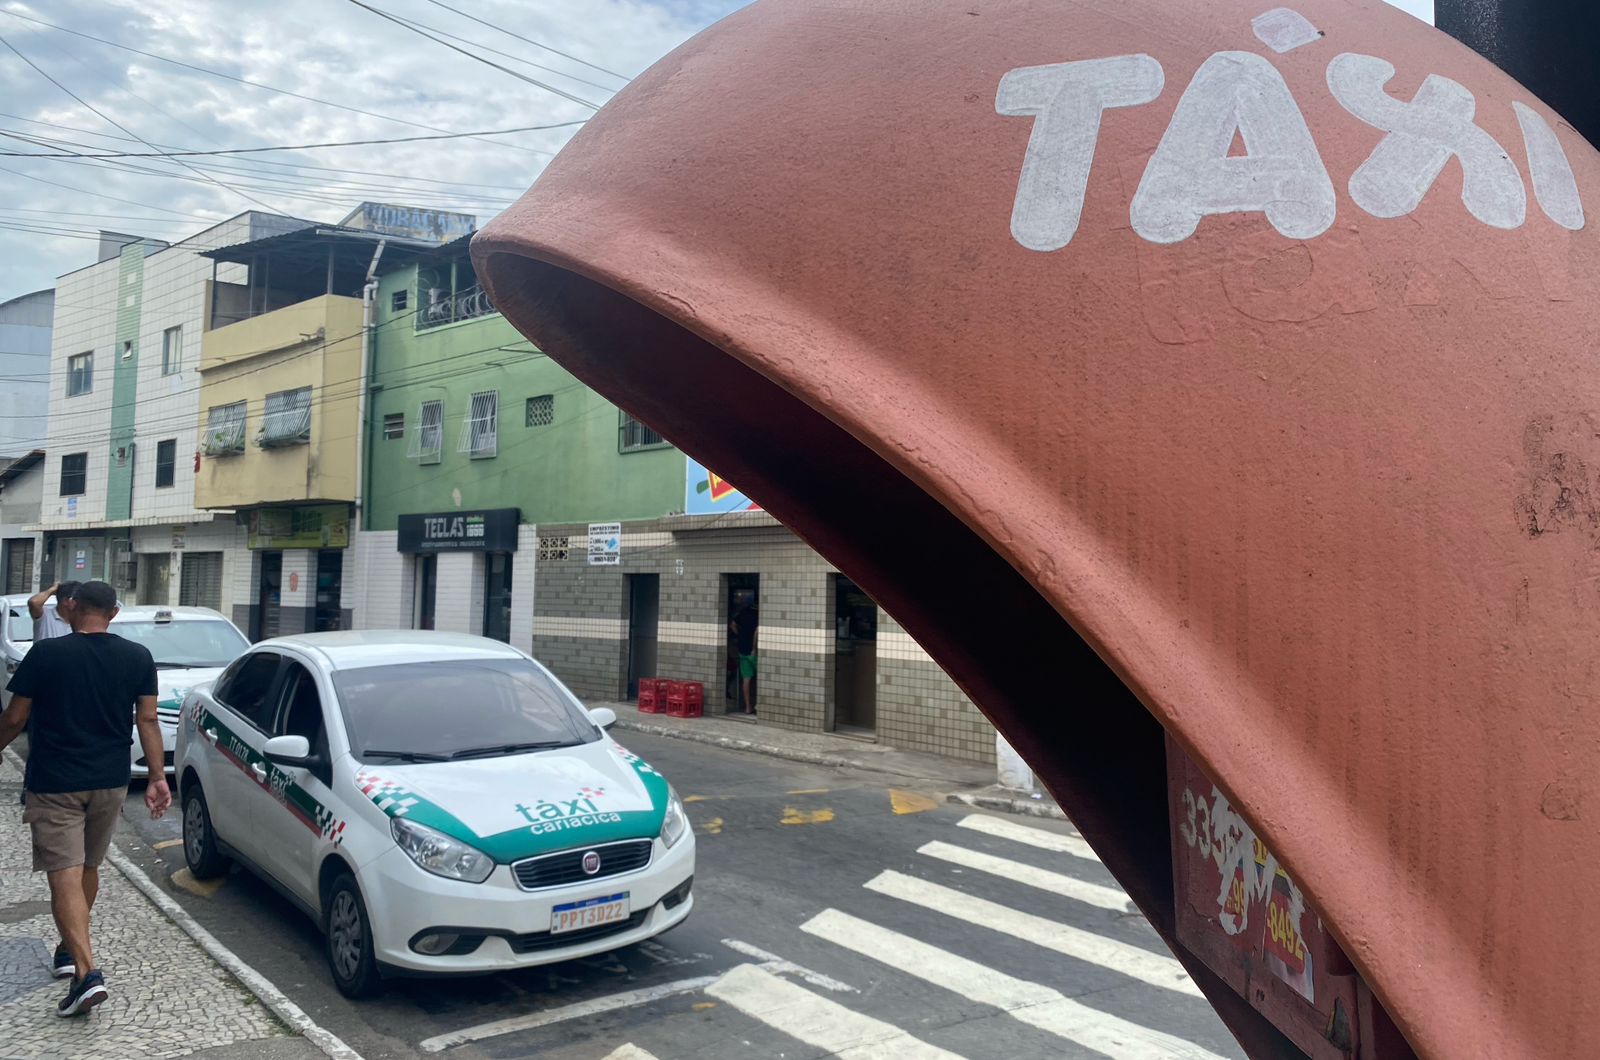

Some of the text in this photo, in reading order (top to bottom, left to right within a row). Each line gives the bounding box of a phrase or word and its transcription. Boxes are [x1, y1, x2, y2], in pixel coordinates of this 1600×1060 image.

[424, 516, 465, 538] TECLAS
[530, 812, 622, 835] cariacica
[559, 902, 625, 930] PPT3D22
